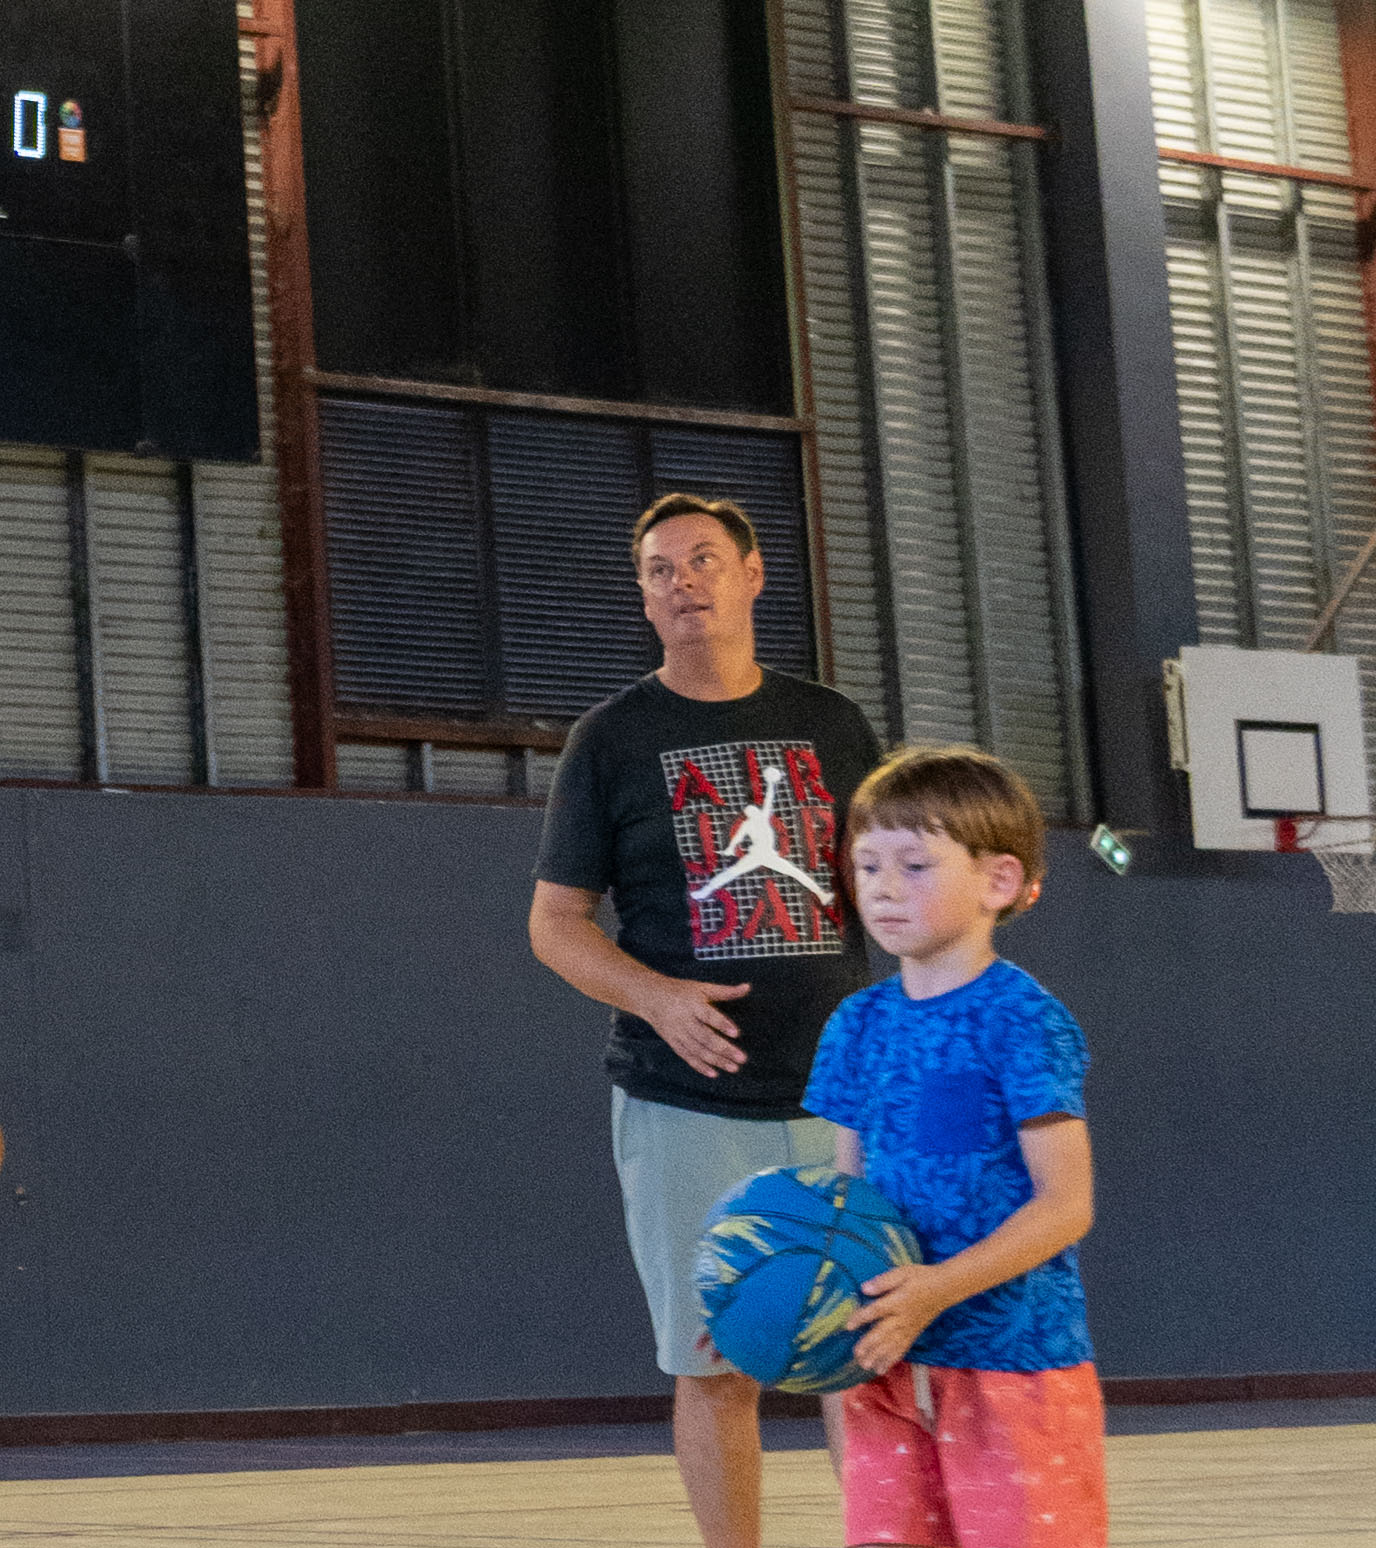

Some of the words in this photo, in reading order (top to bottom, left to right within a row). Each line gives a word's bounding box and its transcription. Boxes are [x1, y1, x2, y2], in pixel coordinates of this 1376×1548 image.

[13, 89, 48, 160] 0
[672, 747, 836, 811] AIR
[688, 878, 845, 948] DAN
